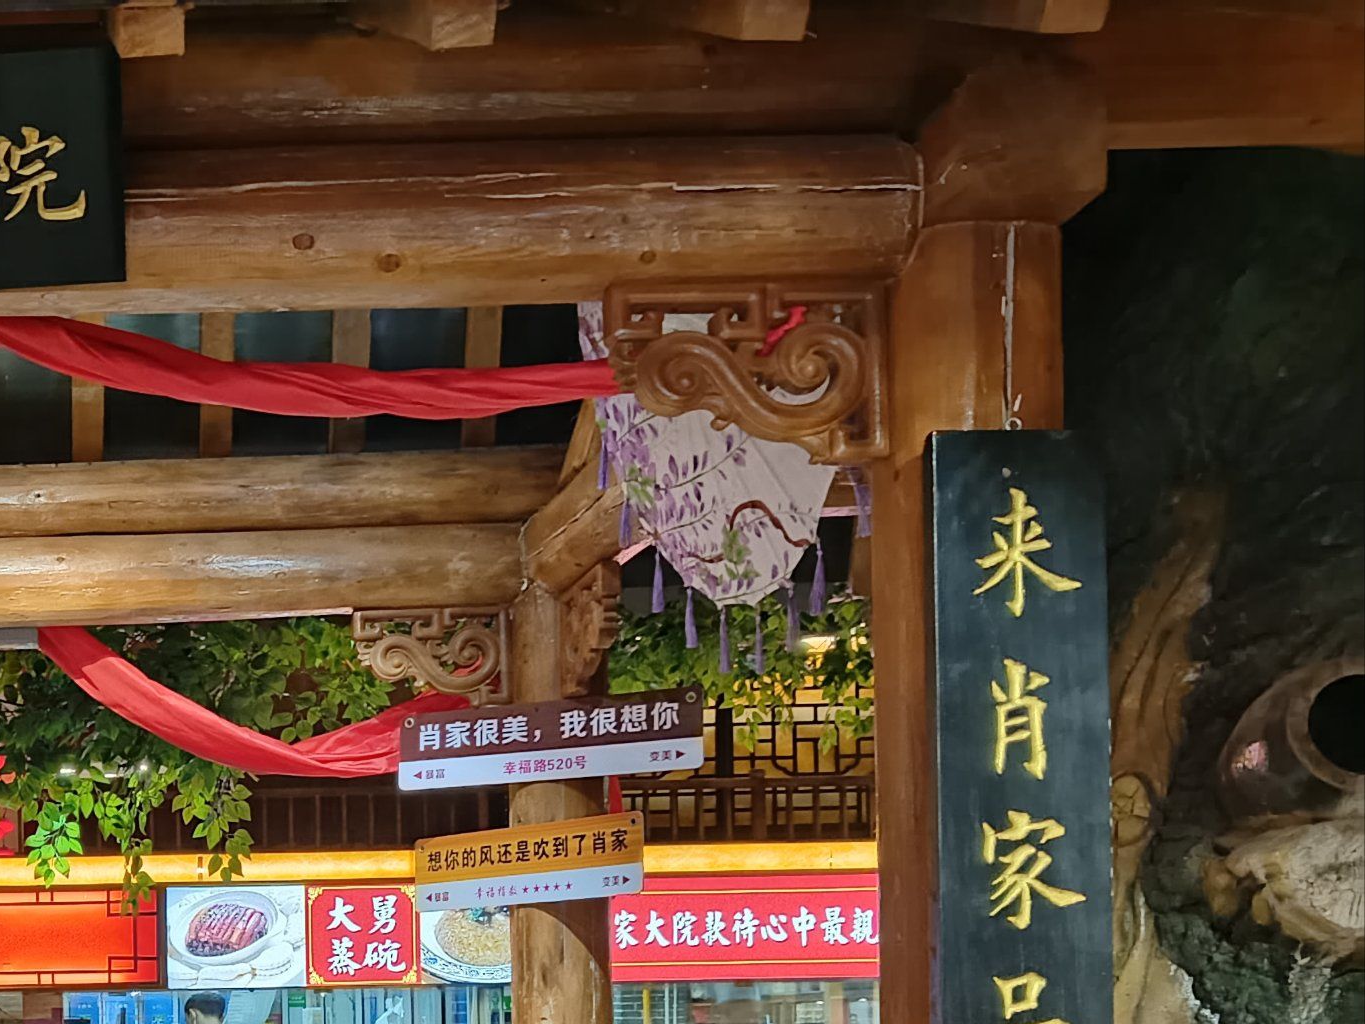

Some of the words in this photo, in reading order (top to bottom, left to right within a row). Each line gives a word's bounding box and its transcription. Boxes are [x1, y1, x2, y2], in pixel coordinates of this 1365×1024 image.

[503, 755, 587, 775] 幸福路520号
[426, 828, 630, 873] 想你的风还是吹到了肖家
[475, 884, 518, 900] 幸福指数
[326, 894, 398, 932] 大舅
[326, 936, 407, 976] 蒸碗
